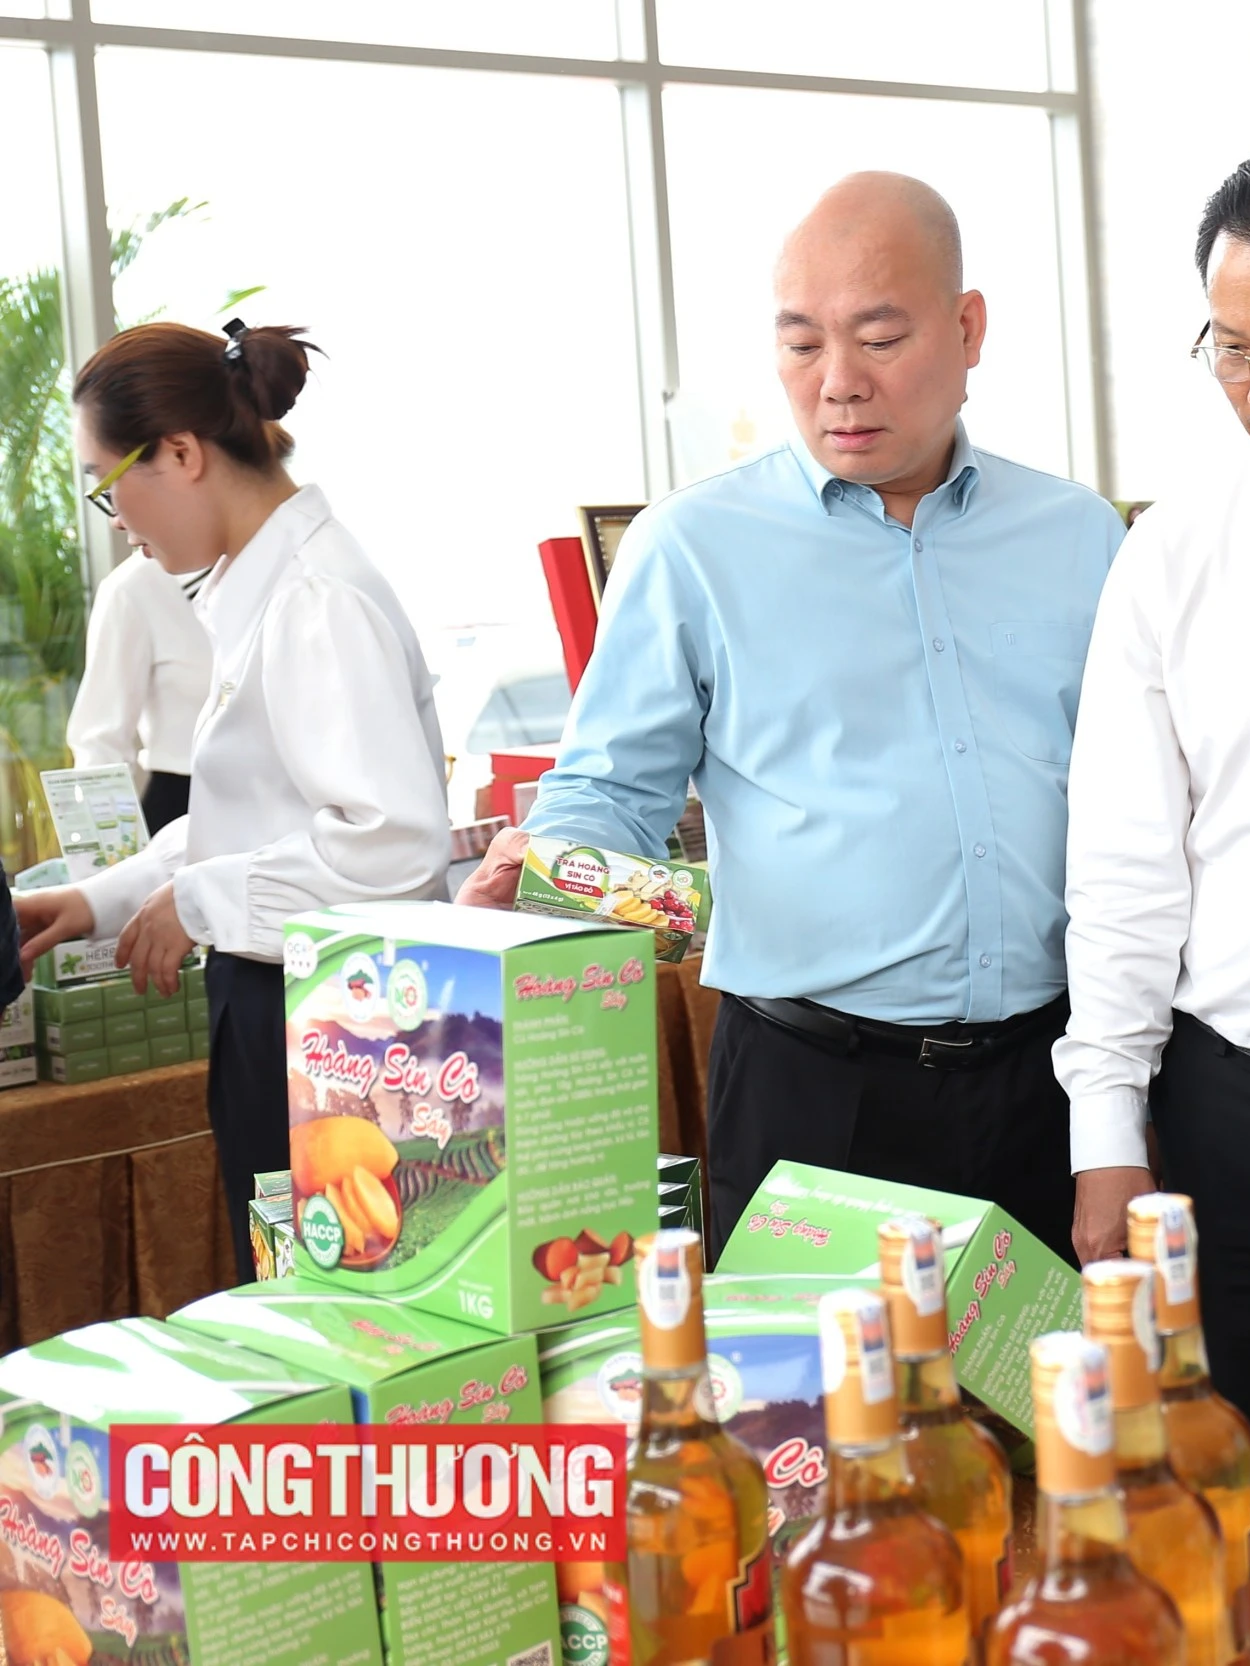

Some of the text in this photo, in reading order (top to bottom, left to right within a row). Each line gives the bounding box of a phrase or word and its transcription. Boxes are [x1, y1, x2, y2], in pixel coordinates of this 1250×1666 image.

[513, 972, 577, 1003] Hoàng
[580, 963, 614, 991] Sin
[301, 1028, 479, 1103] Hoàng Sin Cô
[303, 1221, 341, 1242] HACCP
[973, 1263, 997, 1299] Sin
[992, 1230, 1011, 1260] Cô
[458, 1290, 494, 1319] 1KG
[458, 1379, 495, 1410] Sin
[763, 1437, 828, 1488] Cô
[0, 1497, 158, 1602] Hoàng Sin Cô
